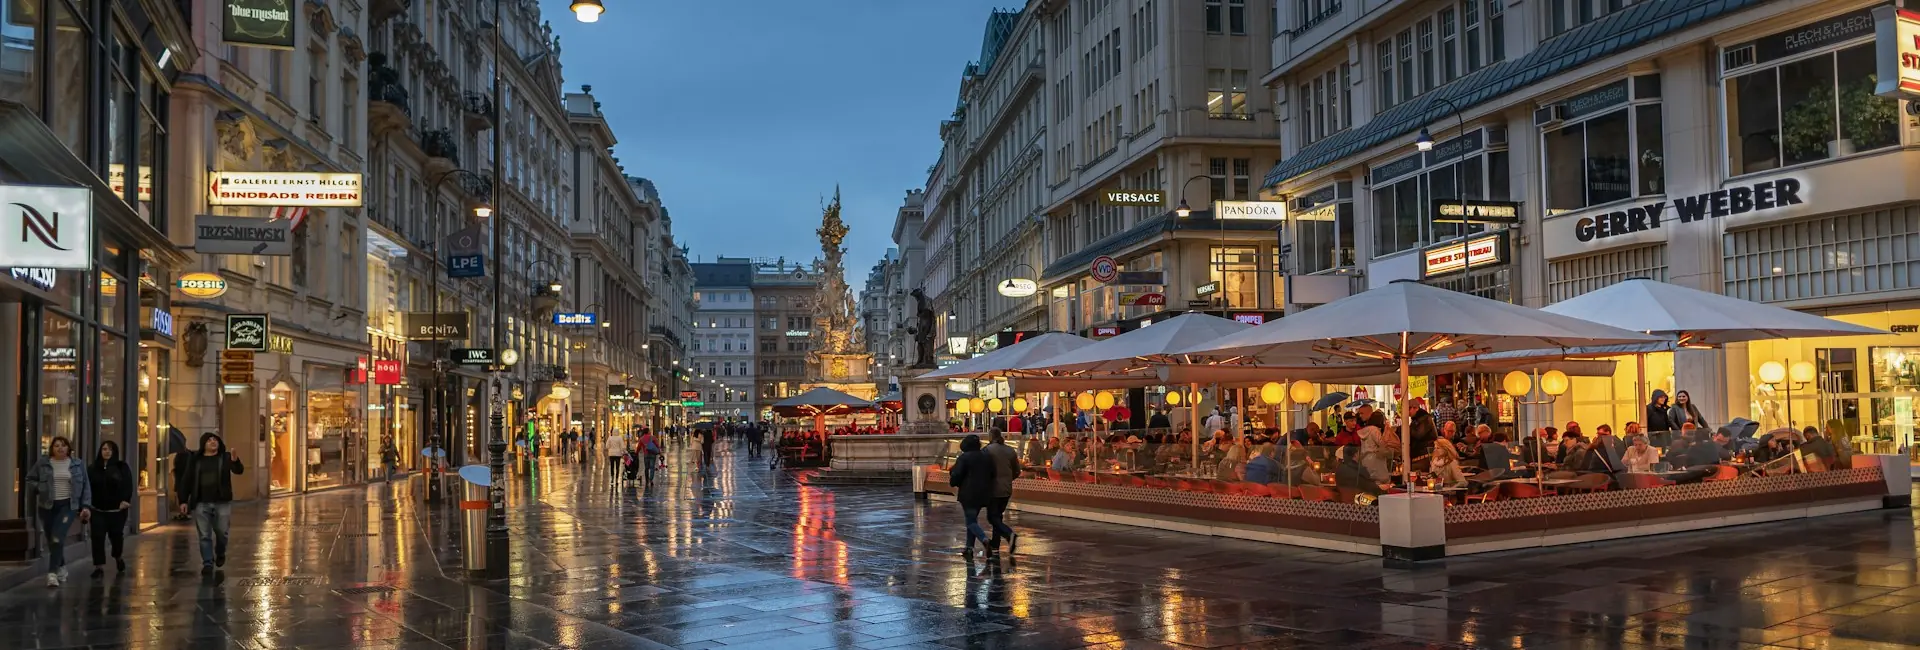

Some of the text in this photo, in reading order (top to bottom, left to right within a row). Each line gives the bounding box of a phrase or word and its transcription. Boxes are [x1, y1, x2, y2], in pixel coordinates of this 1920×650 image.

[1785, 27, 1822, 45] PLECH
[1833, 12, 1873, 32] PLECH
[305, 192, 358, 200] REISEN
[1107, 193, 1160, 203] VERSACE
[1477, 205, 1516, 217] WEBER
[1575, 178, 1803, 243] GERRY WEBER
[452, 256, 478, 268] LPE
[181, 280, 223, 288] FOSSIL
[1197, 283, 1215, 294] VERSACE
[154, 308, 172, 336] FOSSIL
[559, 314, 591, 323] Berlitz
[1890, 324, 1919, 332] GERRY
[468, 350, 487, 359] IWC
